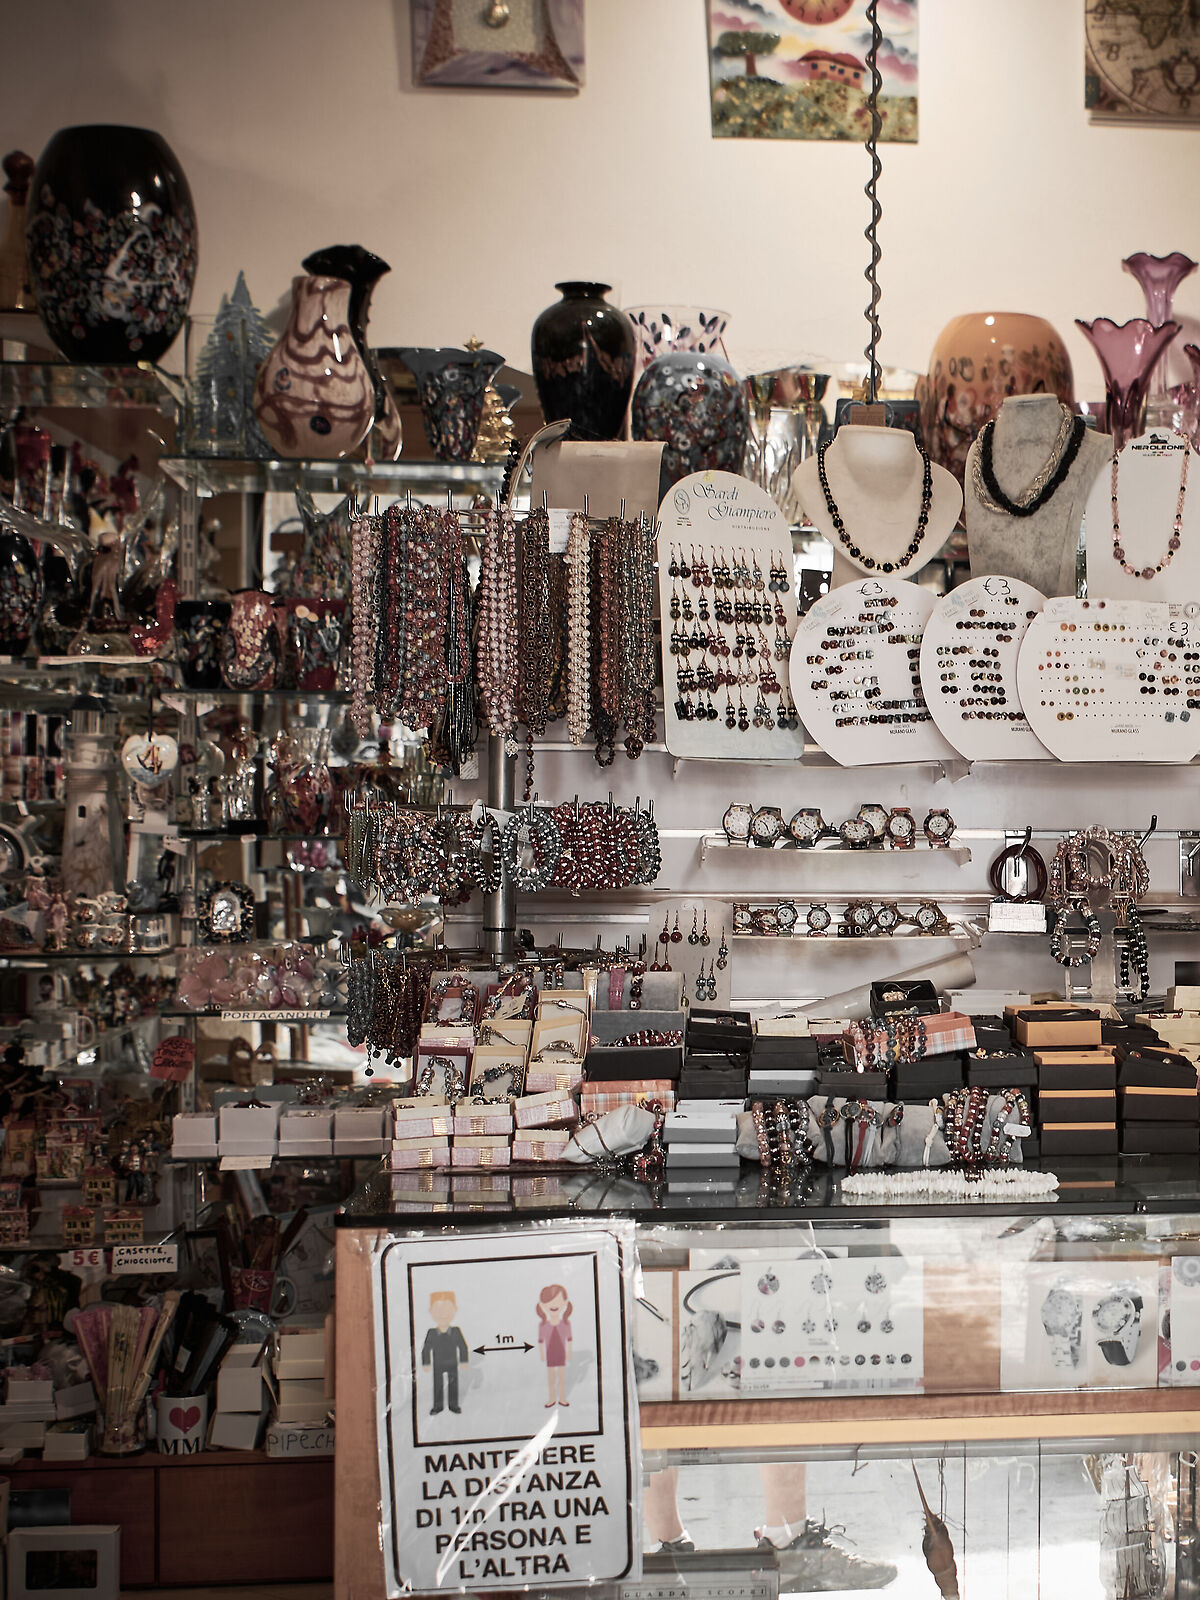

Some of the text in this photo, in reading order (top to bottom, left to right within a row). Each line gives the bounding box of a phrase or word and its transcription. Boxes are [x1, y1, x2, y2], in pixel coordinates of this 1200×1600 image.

[692, 483, 739, 501] Sardi
[708, 502, 776, 522] Giampiero
[495, 1334, 515, 1344] 1m
[422, 1480, 457, 1500] LA
[415, 1508, 442, 1528] DI
[499, 1500, 546, 1522] TRA
[554, 1496, 610, 1518] UNA
[436, 1524, 592, 1553] PERSONA E
[459, 1553, 570, 1580] L'ALTRA
[625, 1590, 687, 1598] GUARDA
